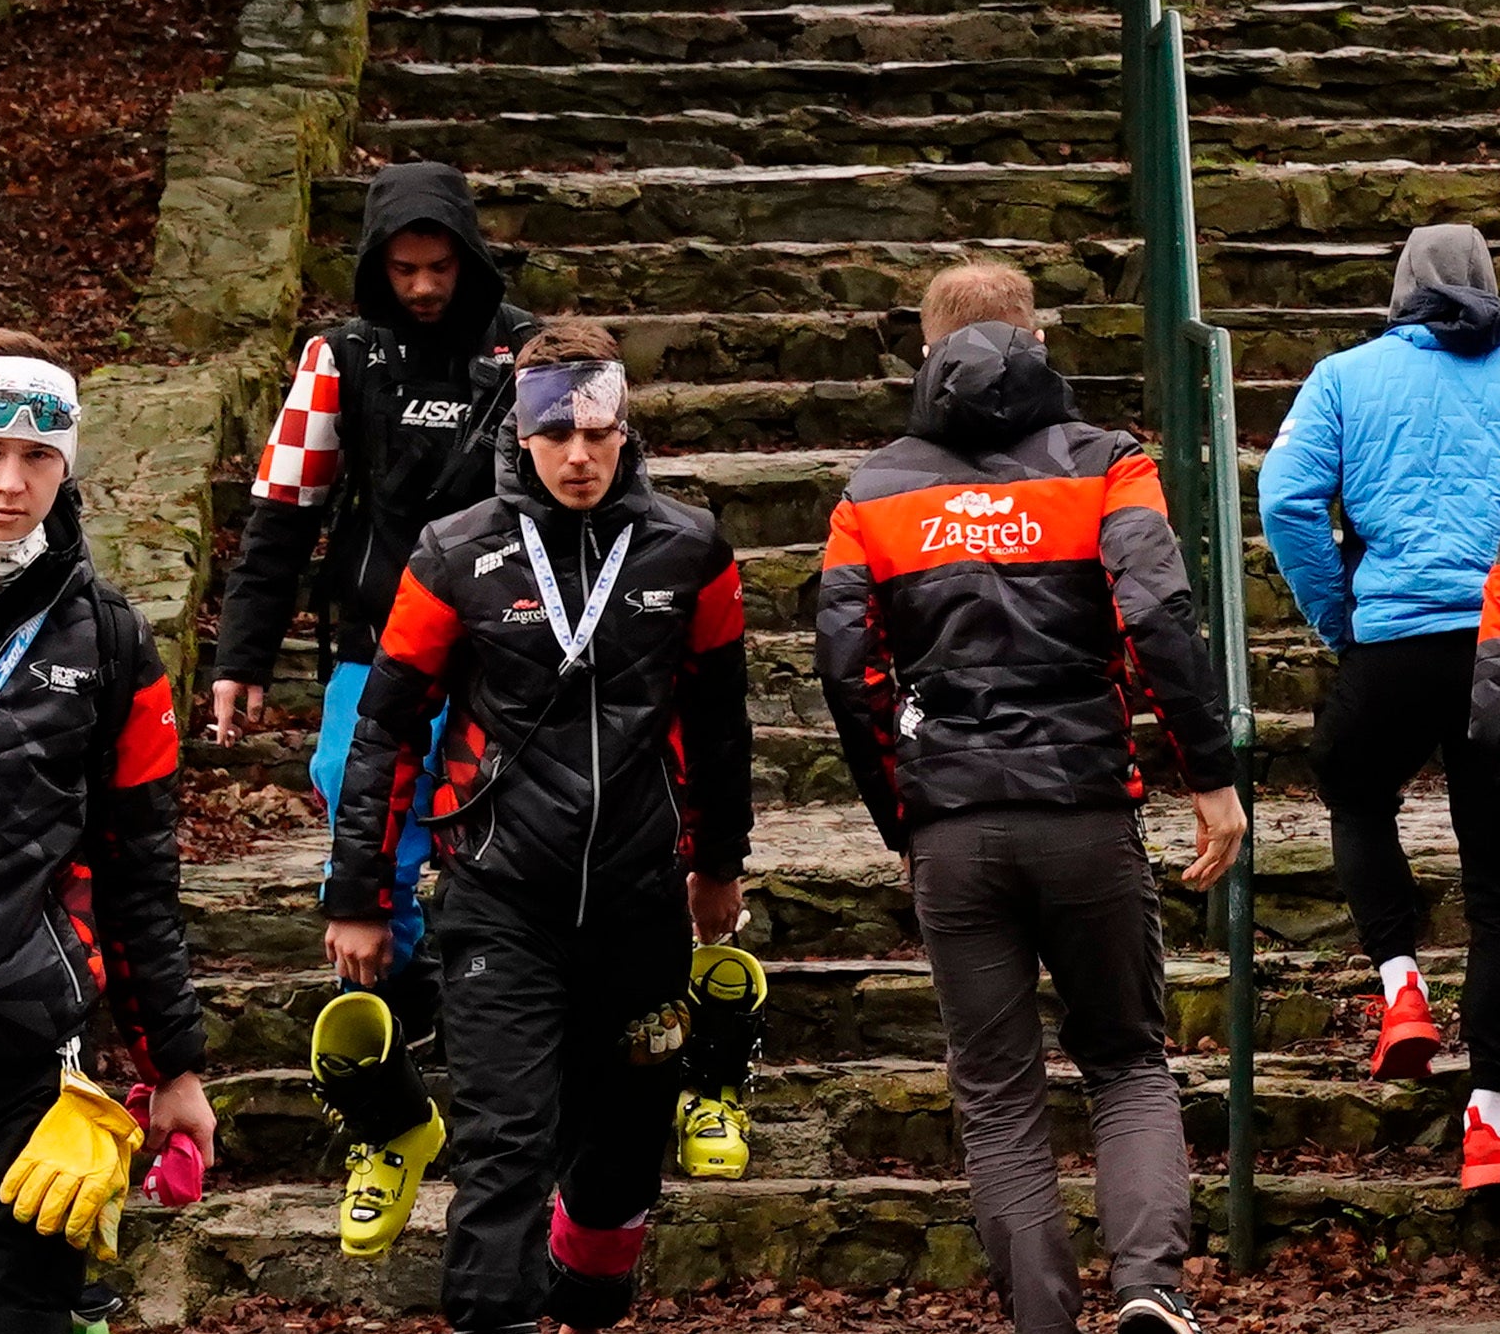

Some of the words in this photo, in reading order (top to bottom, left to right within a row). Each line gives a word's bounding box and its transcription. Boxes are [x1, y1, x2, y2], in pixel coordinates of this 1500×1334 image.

[920, 512, 1043, 554] Zagreb
[989, 546, 1030, 555] CROATIA
[502, 605, 548, 625] Zagreb
